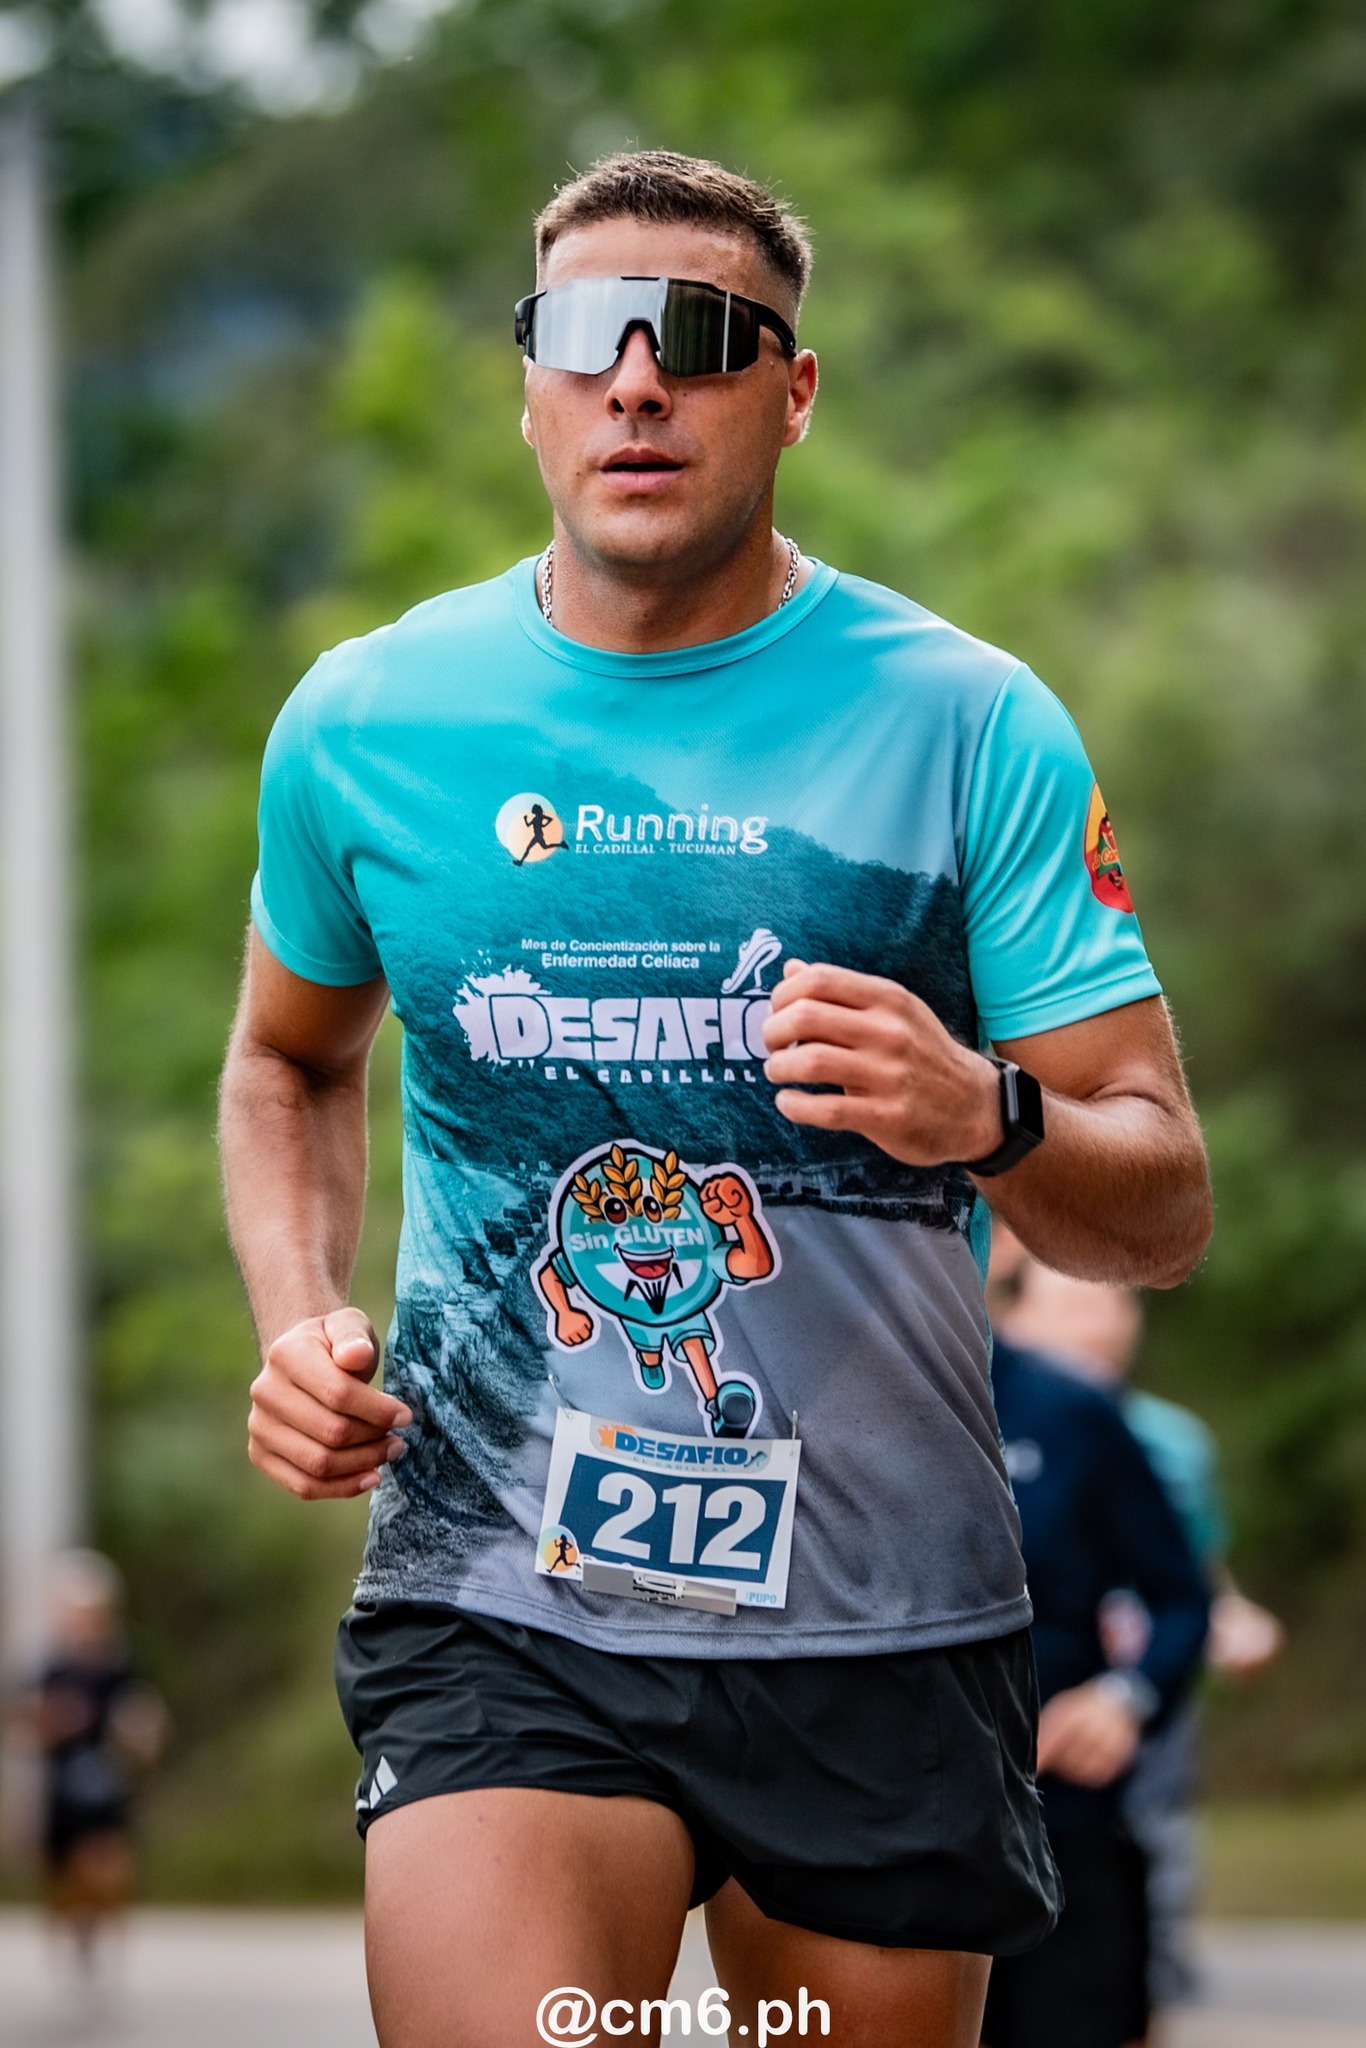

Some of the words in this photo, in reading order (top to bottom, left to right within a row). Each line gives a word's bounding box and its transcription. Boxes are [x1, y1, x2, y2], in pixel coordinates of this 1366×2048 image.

[575, 803, 769, 855] Running
[575, 843, 590, 854] EL
[593, 843, 656, 854] CADILLAL
[669, 842, 736, 855] TUCUMAN
[521, 938, 548, 950] Mes
[550, 939, 567, 951] de
[569, 939, 669, 952] Concientización
[671, 940, 707, 952] sobre
[709, 941, 721, 952] la
[541, 953, 637, 969] Enfermedad
[544, 1066, 580, 1080] EL
[597, 1068, 757, 1084] CADILLAL
[568, 1231, 609, 1252] Sin
[614, 1224, 705, 1247] GLUTEN
[614, 1430, 749, 1466] DESAFIO
[591, 1471, 767, 1571] 212
